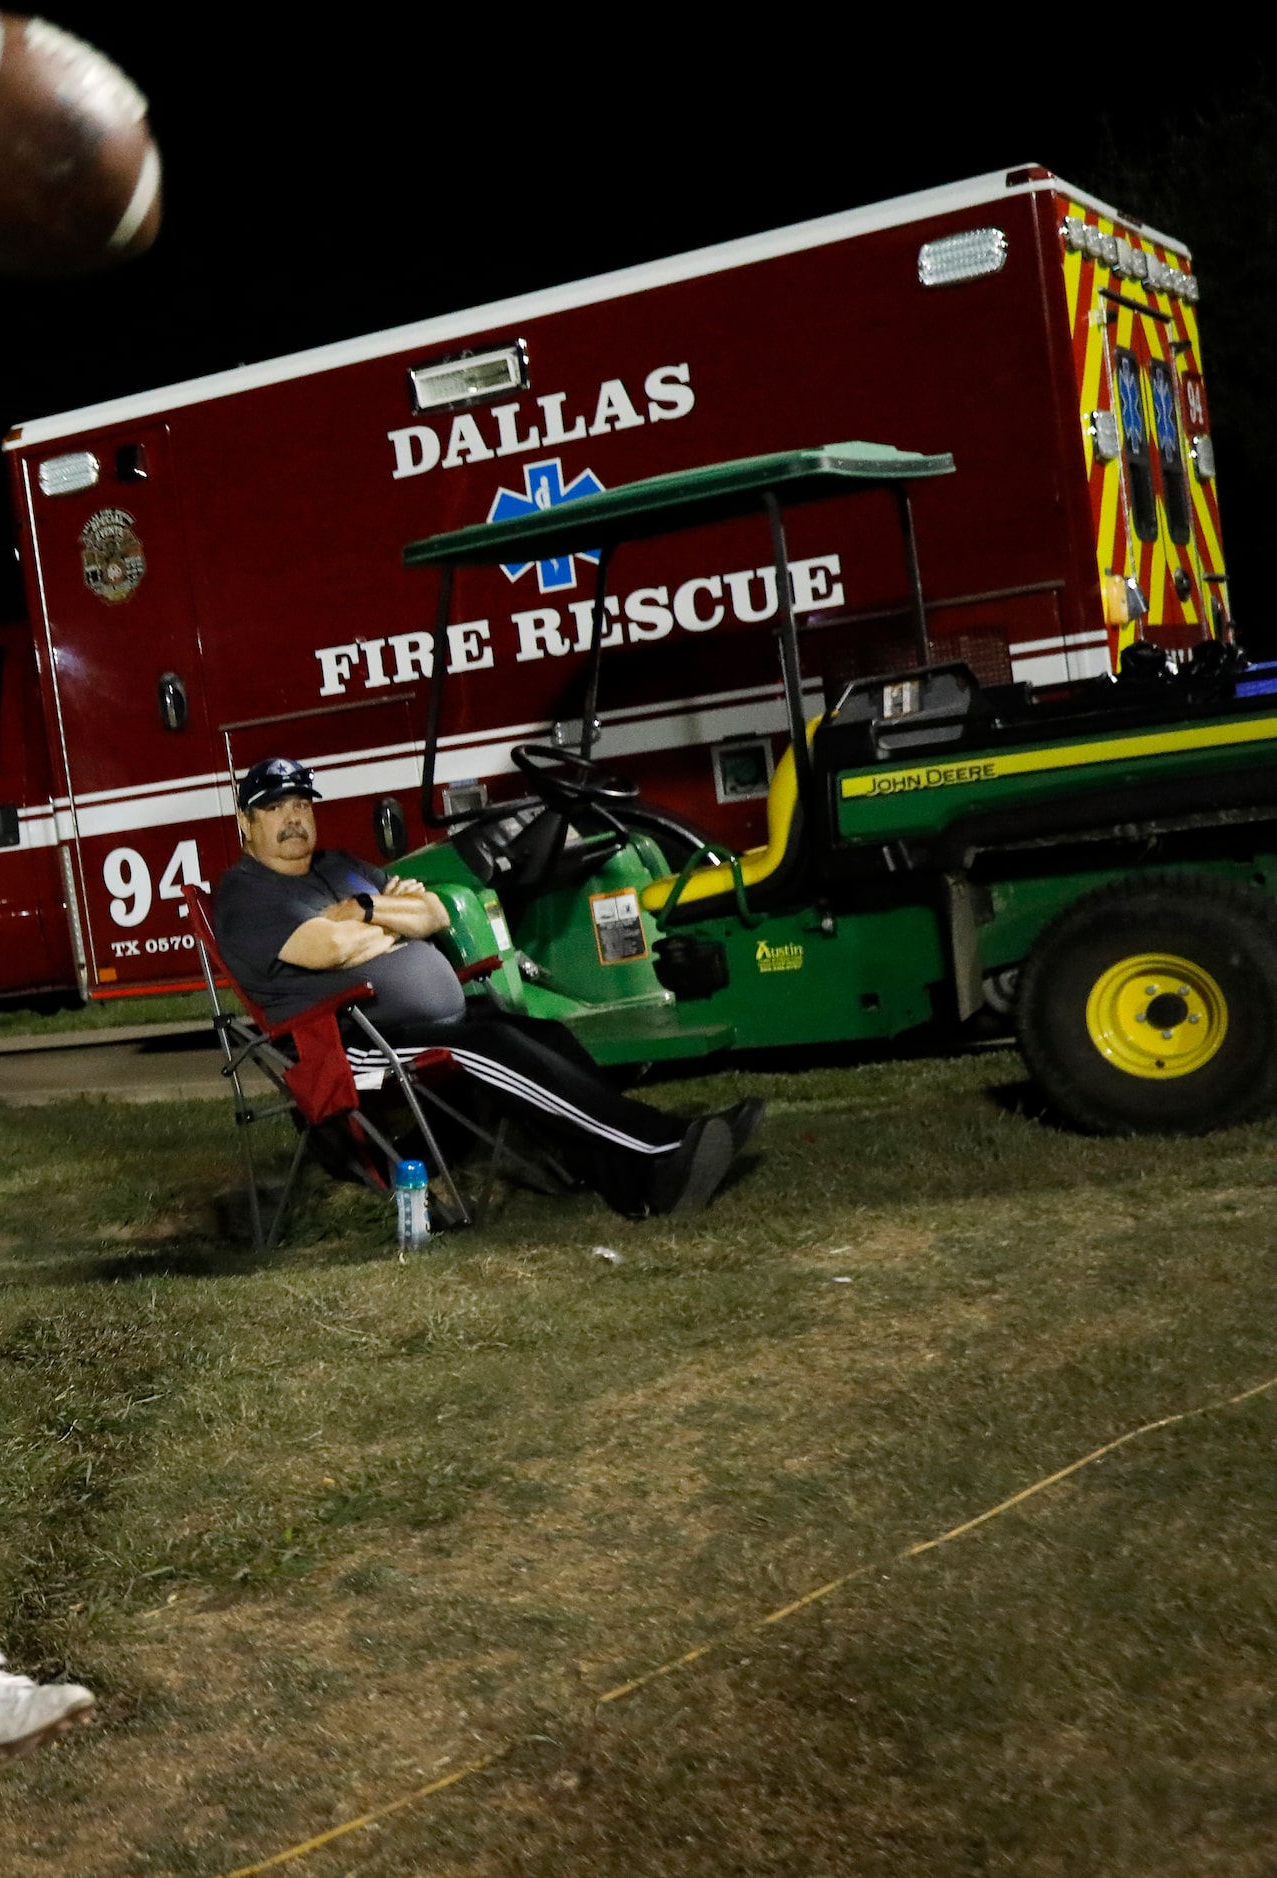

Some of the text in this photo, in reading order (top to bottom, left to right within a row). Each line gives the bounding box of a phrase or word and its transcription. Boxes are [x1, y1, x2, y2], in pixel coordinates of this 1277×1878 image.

[387, 363, 696, 480] DALLAS
[315, 554, 845, 696] FIRE RESCUE
[866, 763, 997, 794] JOHN DEERE
[103, 839, 211, 928] 94
[111, 940, 141, 957] TX
